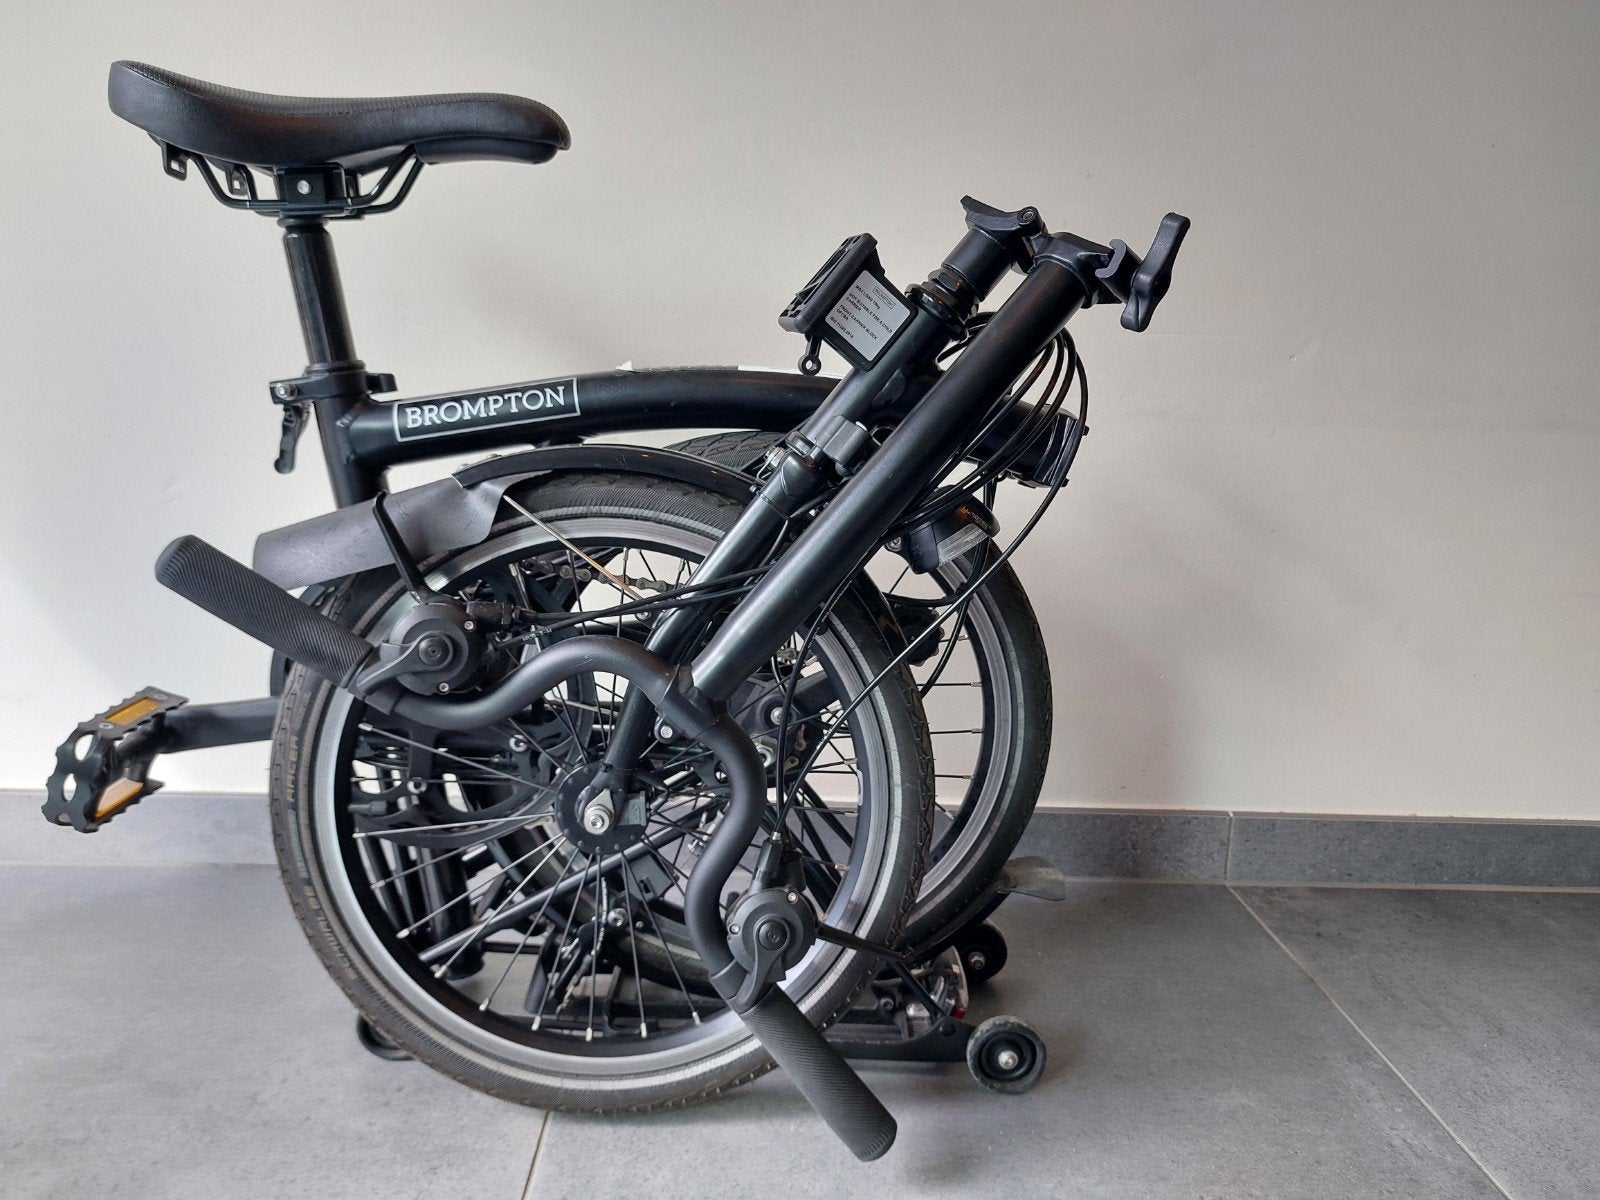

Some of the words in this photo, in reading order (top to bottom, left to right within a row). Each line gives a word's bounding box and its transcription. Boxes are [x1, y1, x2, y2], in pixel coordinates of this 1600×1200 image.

[845, 296, 861, 311] CARRIER
[855, 284, 864, 293] MAX
[862, 291, 873, 301] LOAD
[839, 304, 852, 316] FRONT
[850, 314, 866, 329] CARRIER
[865, 327, 878, 340] BLOCK
[856, 299, 873, 316] SUITABLE
[871, 313, 880, 321] FOR
[881, 322, 892, 333] CHILD
[404, 386, 565, 428] BROMPTON
[286, 735, 299, 802] RACER
